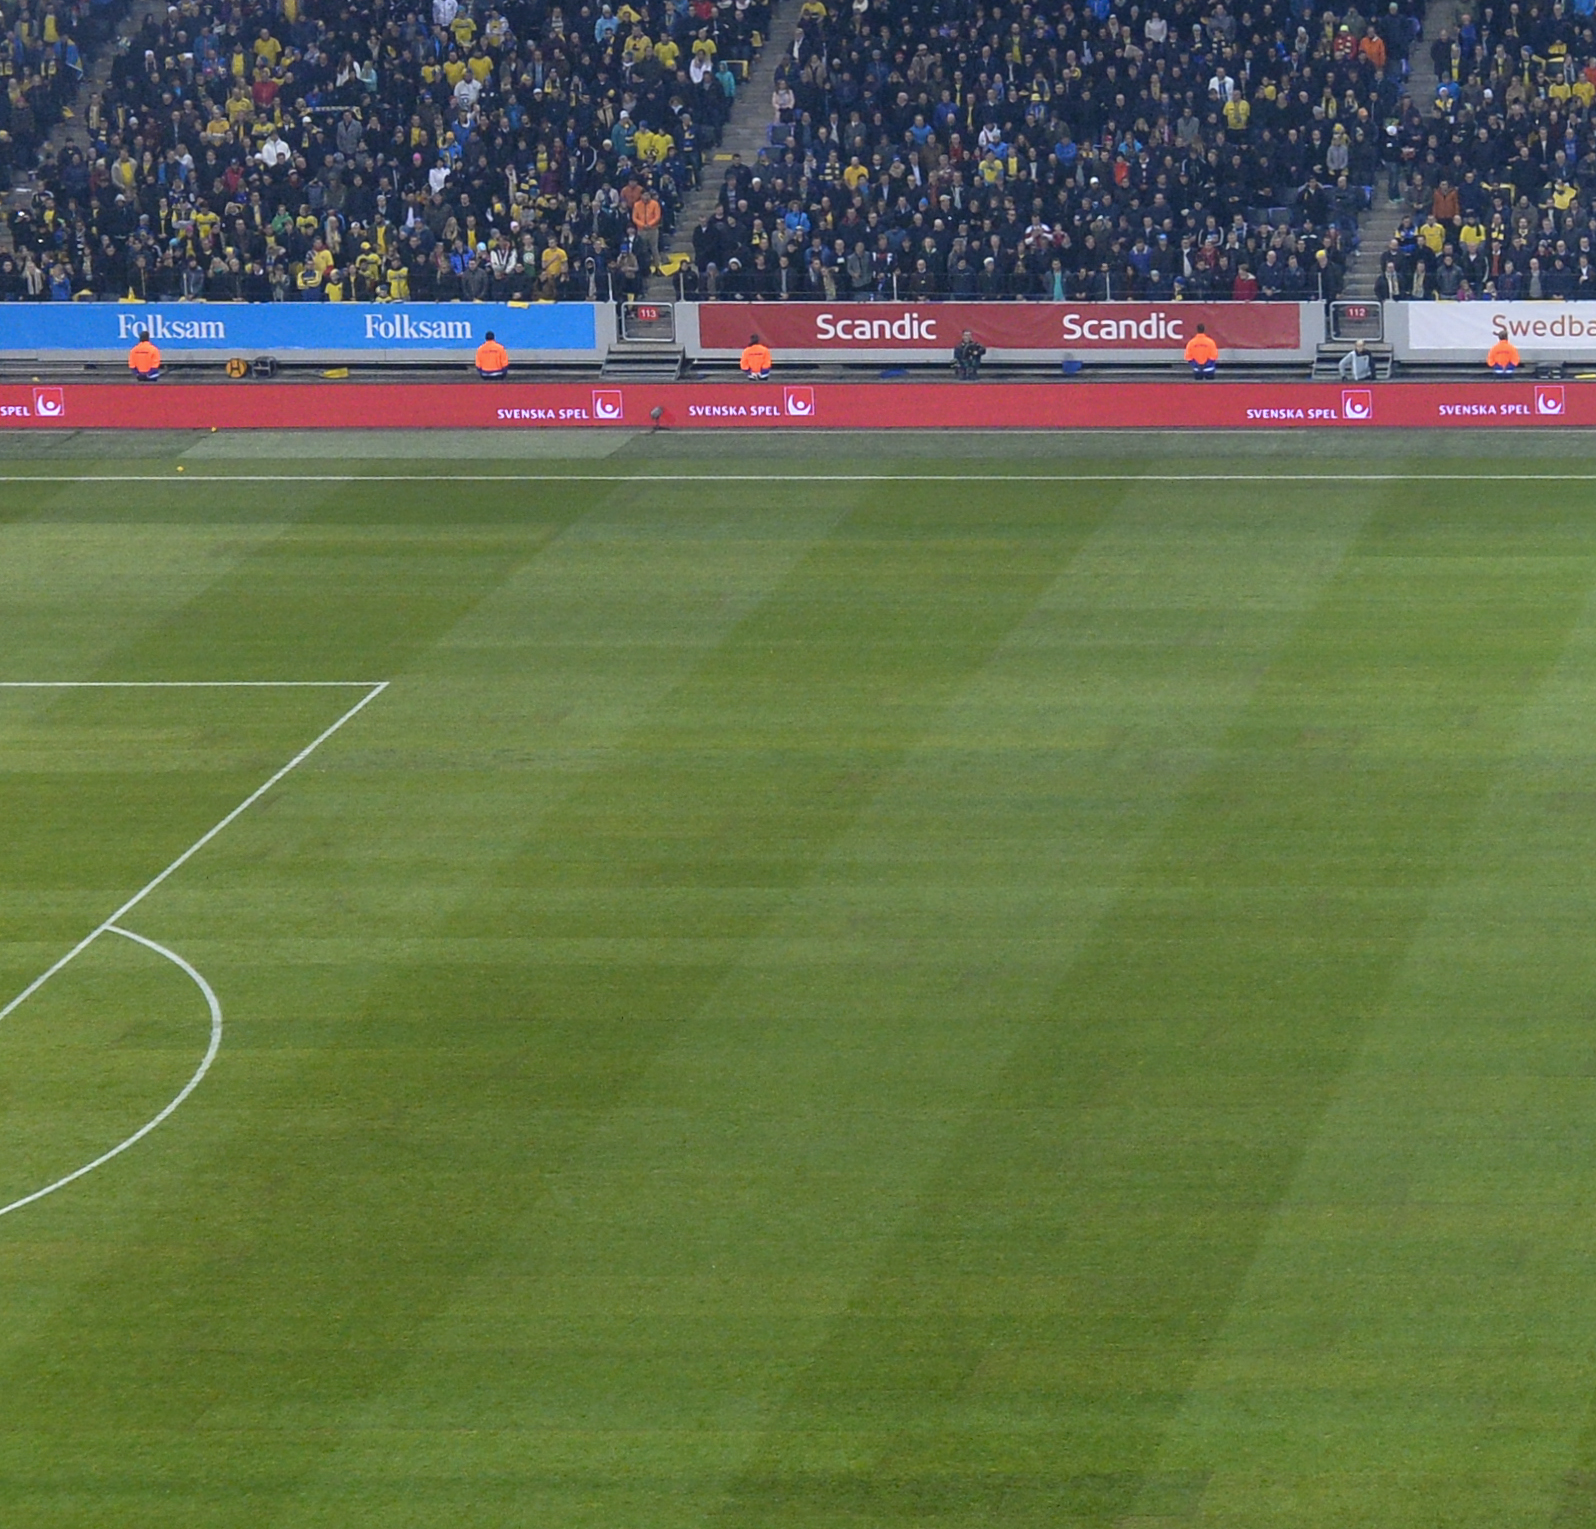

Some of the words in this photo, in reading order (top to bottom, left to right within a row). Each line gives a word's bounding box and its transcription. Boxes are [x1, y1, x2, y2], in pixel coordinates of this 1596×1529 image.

[641, 308, 657, 318] 113
[1349, 308, 1365, 317] 112
[117, 314, 226, 339] Folksam
[364, 314, 473, 339] Folksam
[815, 312, 937, 340] Scandic
[1062, 312, 1184, 340] Scandic
[0, 406, 31, 417] SPEL
[497, 408, 555, 419] SVENSKA
[559, 408, 589, 419] SPEL
[688, 405, 746, 416] SVENSKA
[750, 405, 781, 416] SPEL
[1246, 408, 1304, 419] SVENSKA
[1307, 408, 1338, 419] SPEL
[1438, 404, 1496, 415] SVENSKA
[1500, 404, 1531, 415] SPEL
